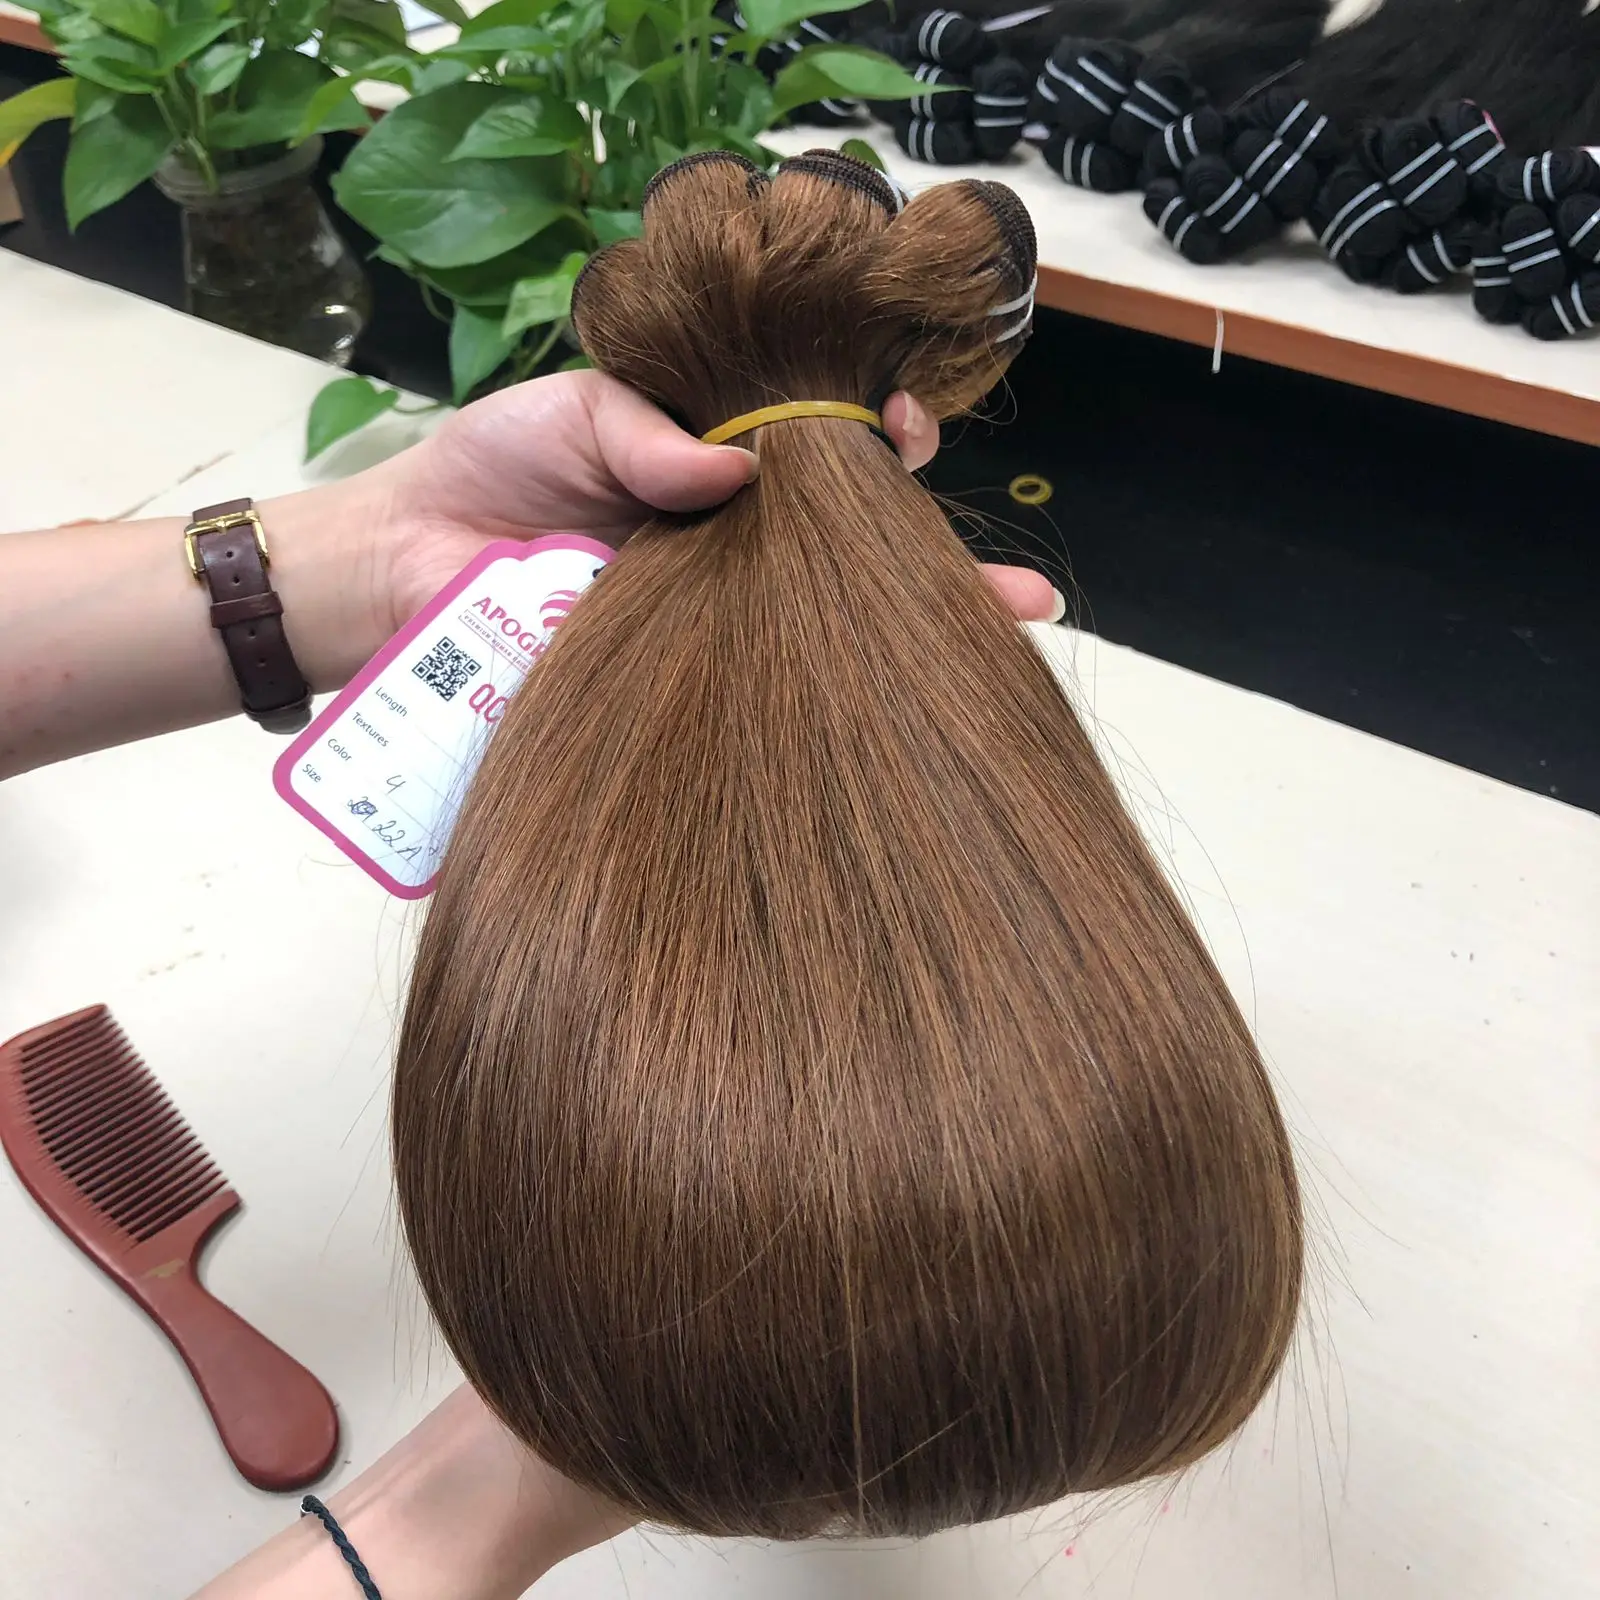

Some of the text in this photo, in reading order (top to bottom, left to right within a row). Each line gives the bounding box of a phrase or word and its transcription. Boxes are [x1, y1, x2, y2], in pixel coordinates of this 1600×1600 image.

[375, 686, 408, 717] Length
[352, 711, 389, 747] Textures
[327, 738, 352, 761] Color
[302, 763, 322, 783] Size
